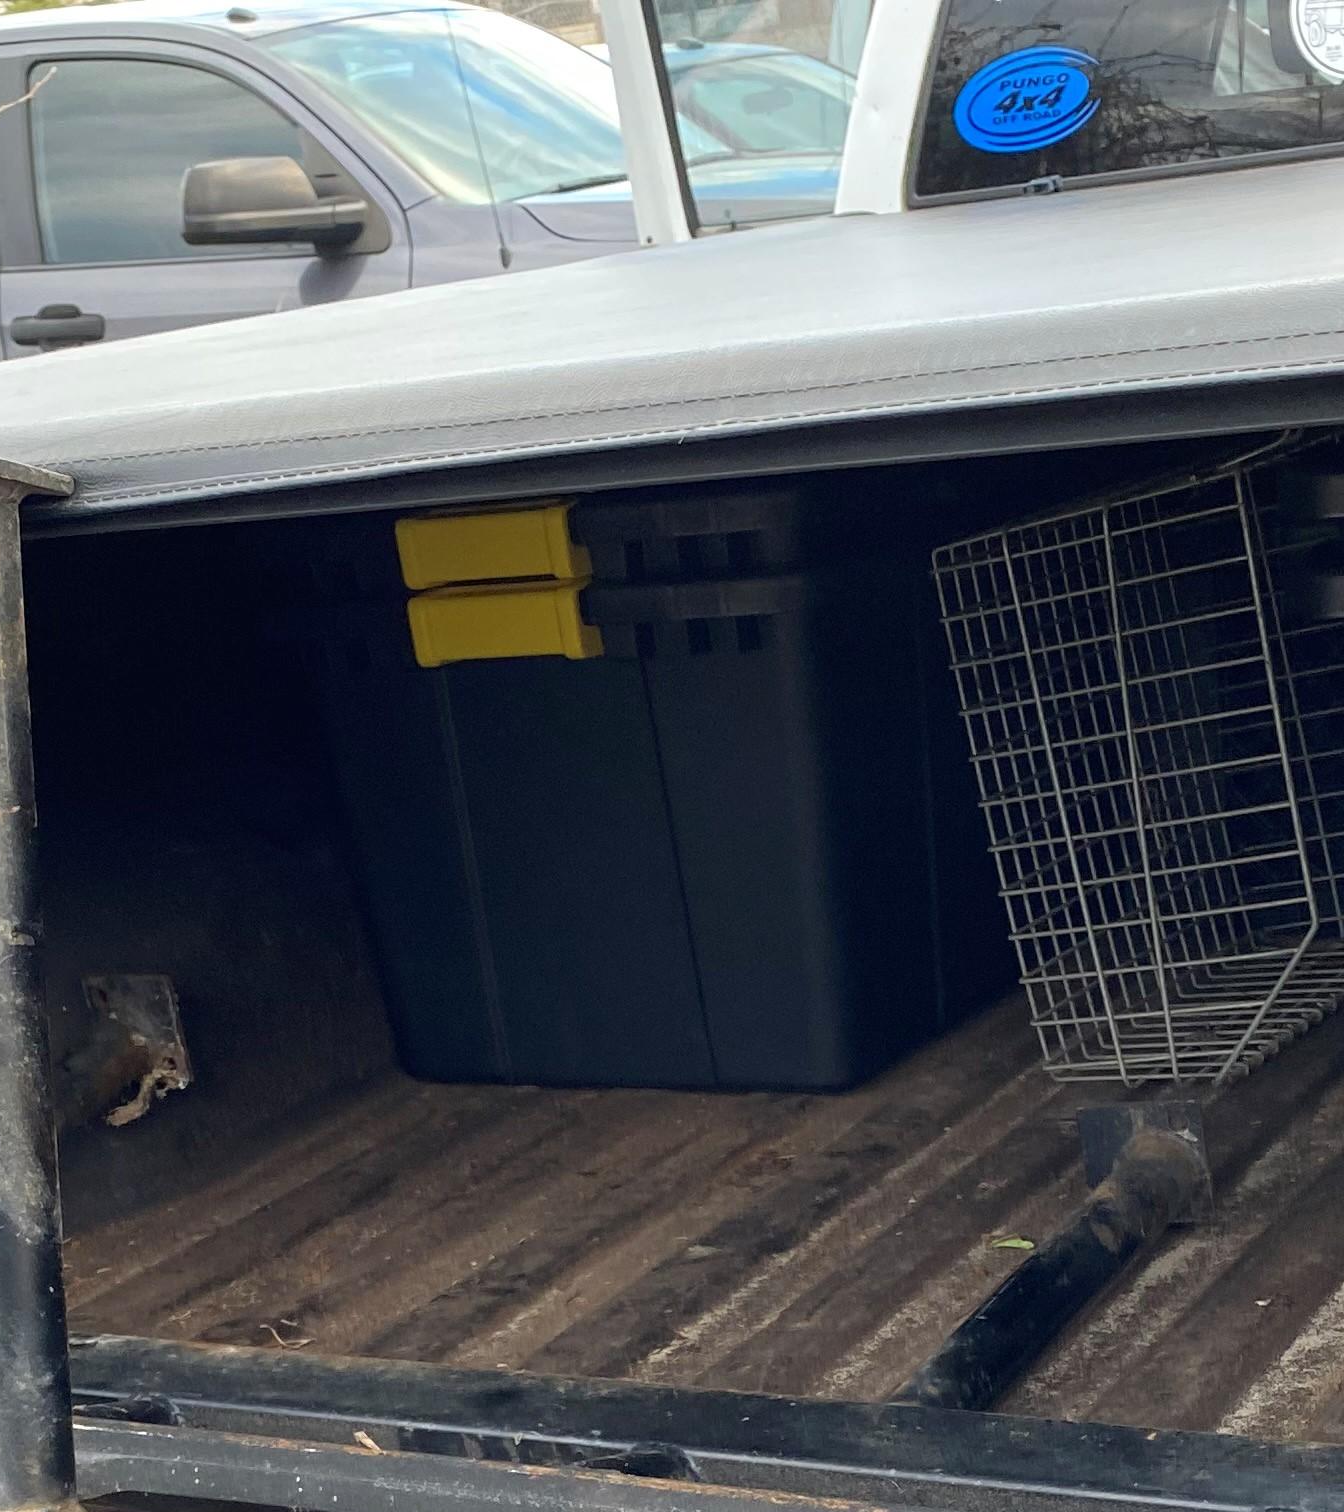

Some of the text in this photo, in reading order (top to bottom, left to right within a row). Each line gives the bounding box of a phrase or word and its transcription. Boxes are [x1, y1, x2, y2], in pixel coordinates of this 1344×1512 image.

[999, 73, 1070, 91] PUNGO
[993, 85, 1067, 115] 4x4
[992, 110, 1062, 125] OFF ROAD
